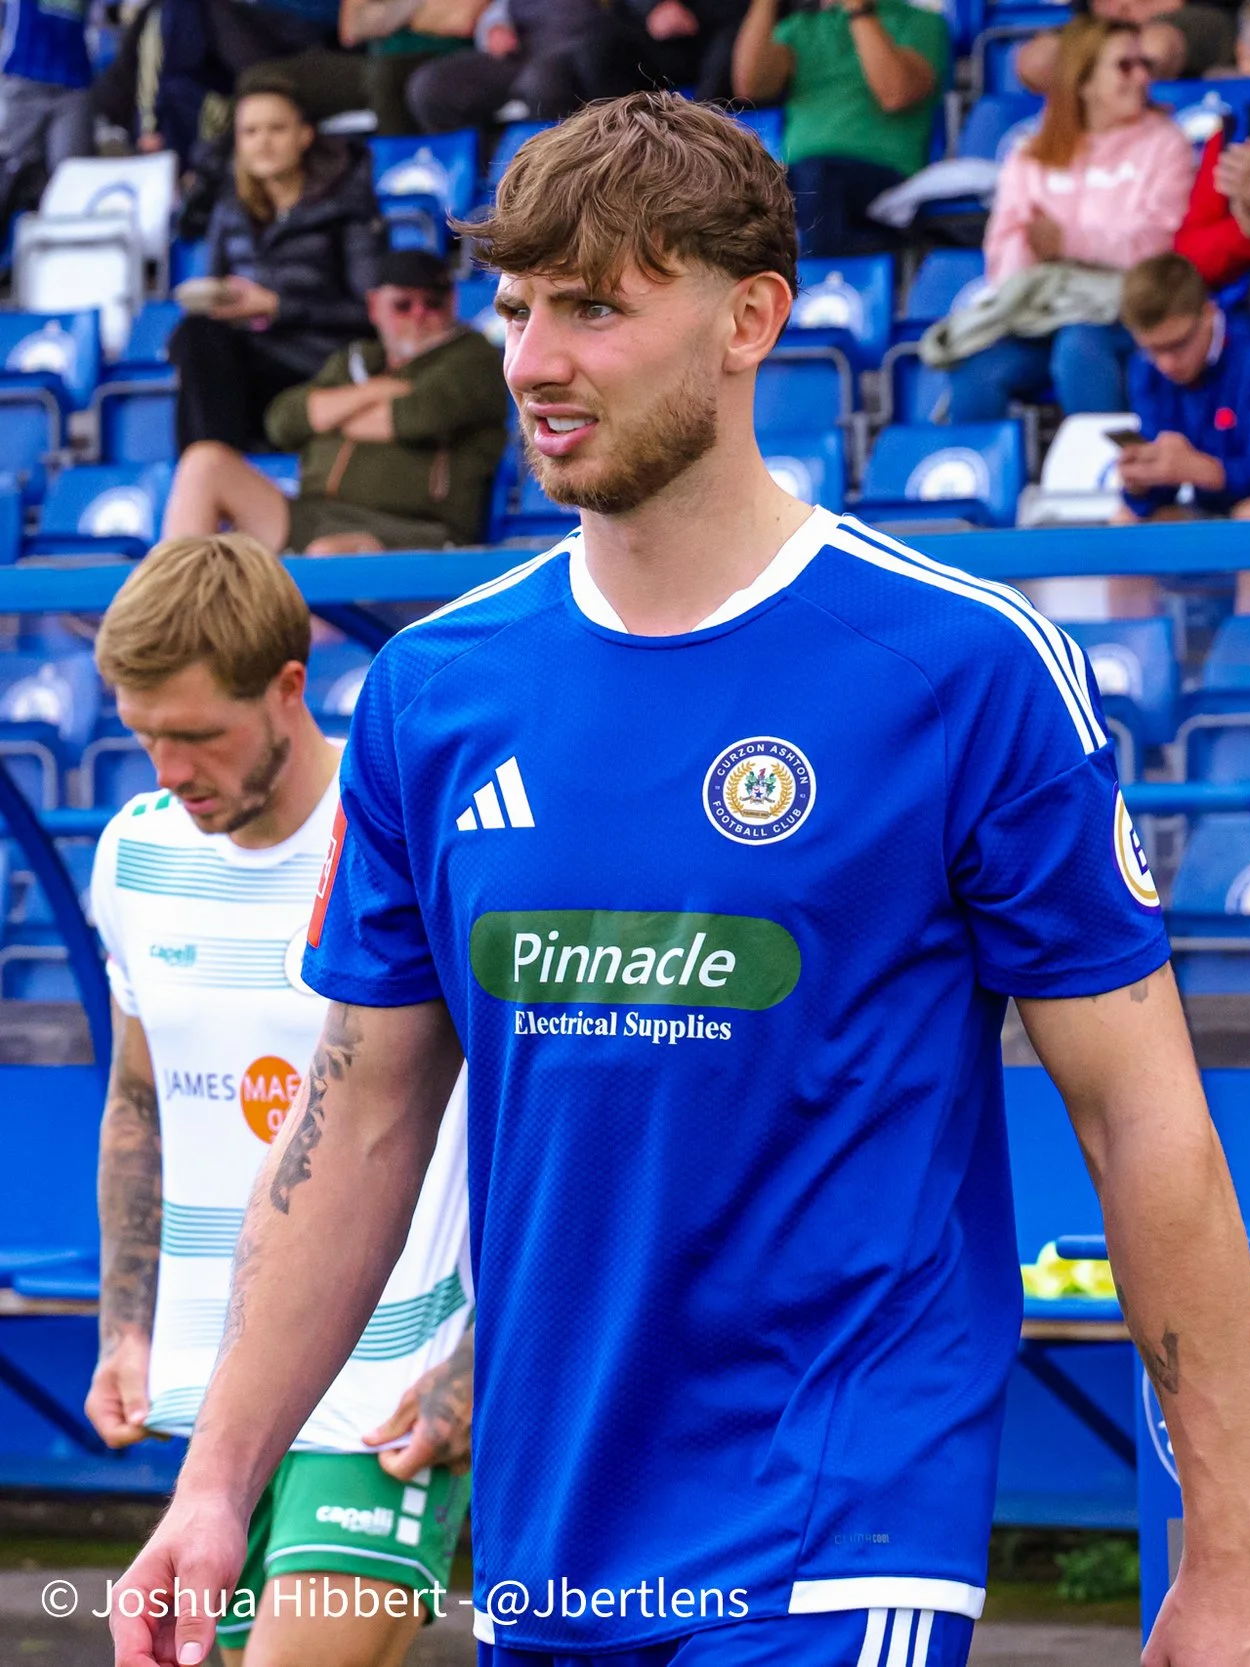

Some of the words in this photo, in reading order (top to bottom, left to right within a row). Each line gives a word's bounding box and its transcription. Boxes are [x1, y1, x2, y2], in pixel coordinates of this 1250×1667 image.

[717, 744, 765, 776] CURZON
[769, 745, 809, 784] ASHTON
[713, 801, 767, 836] FOOTBALL
[772, 808, 802, 833] CLUB
[513, 930, 736, 988] Pinnacle
[513, 1010, 617, 1036] Electrical
[623, 1011, 732, 1045] Supplies
[165, 1069, 237, 1101] JAMES
[316, 1505, 394, 1531] capelli
